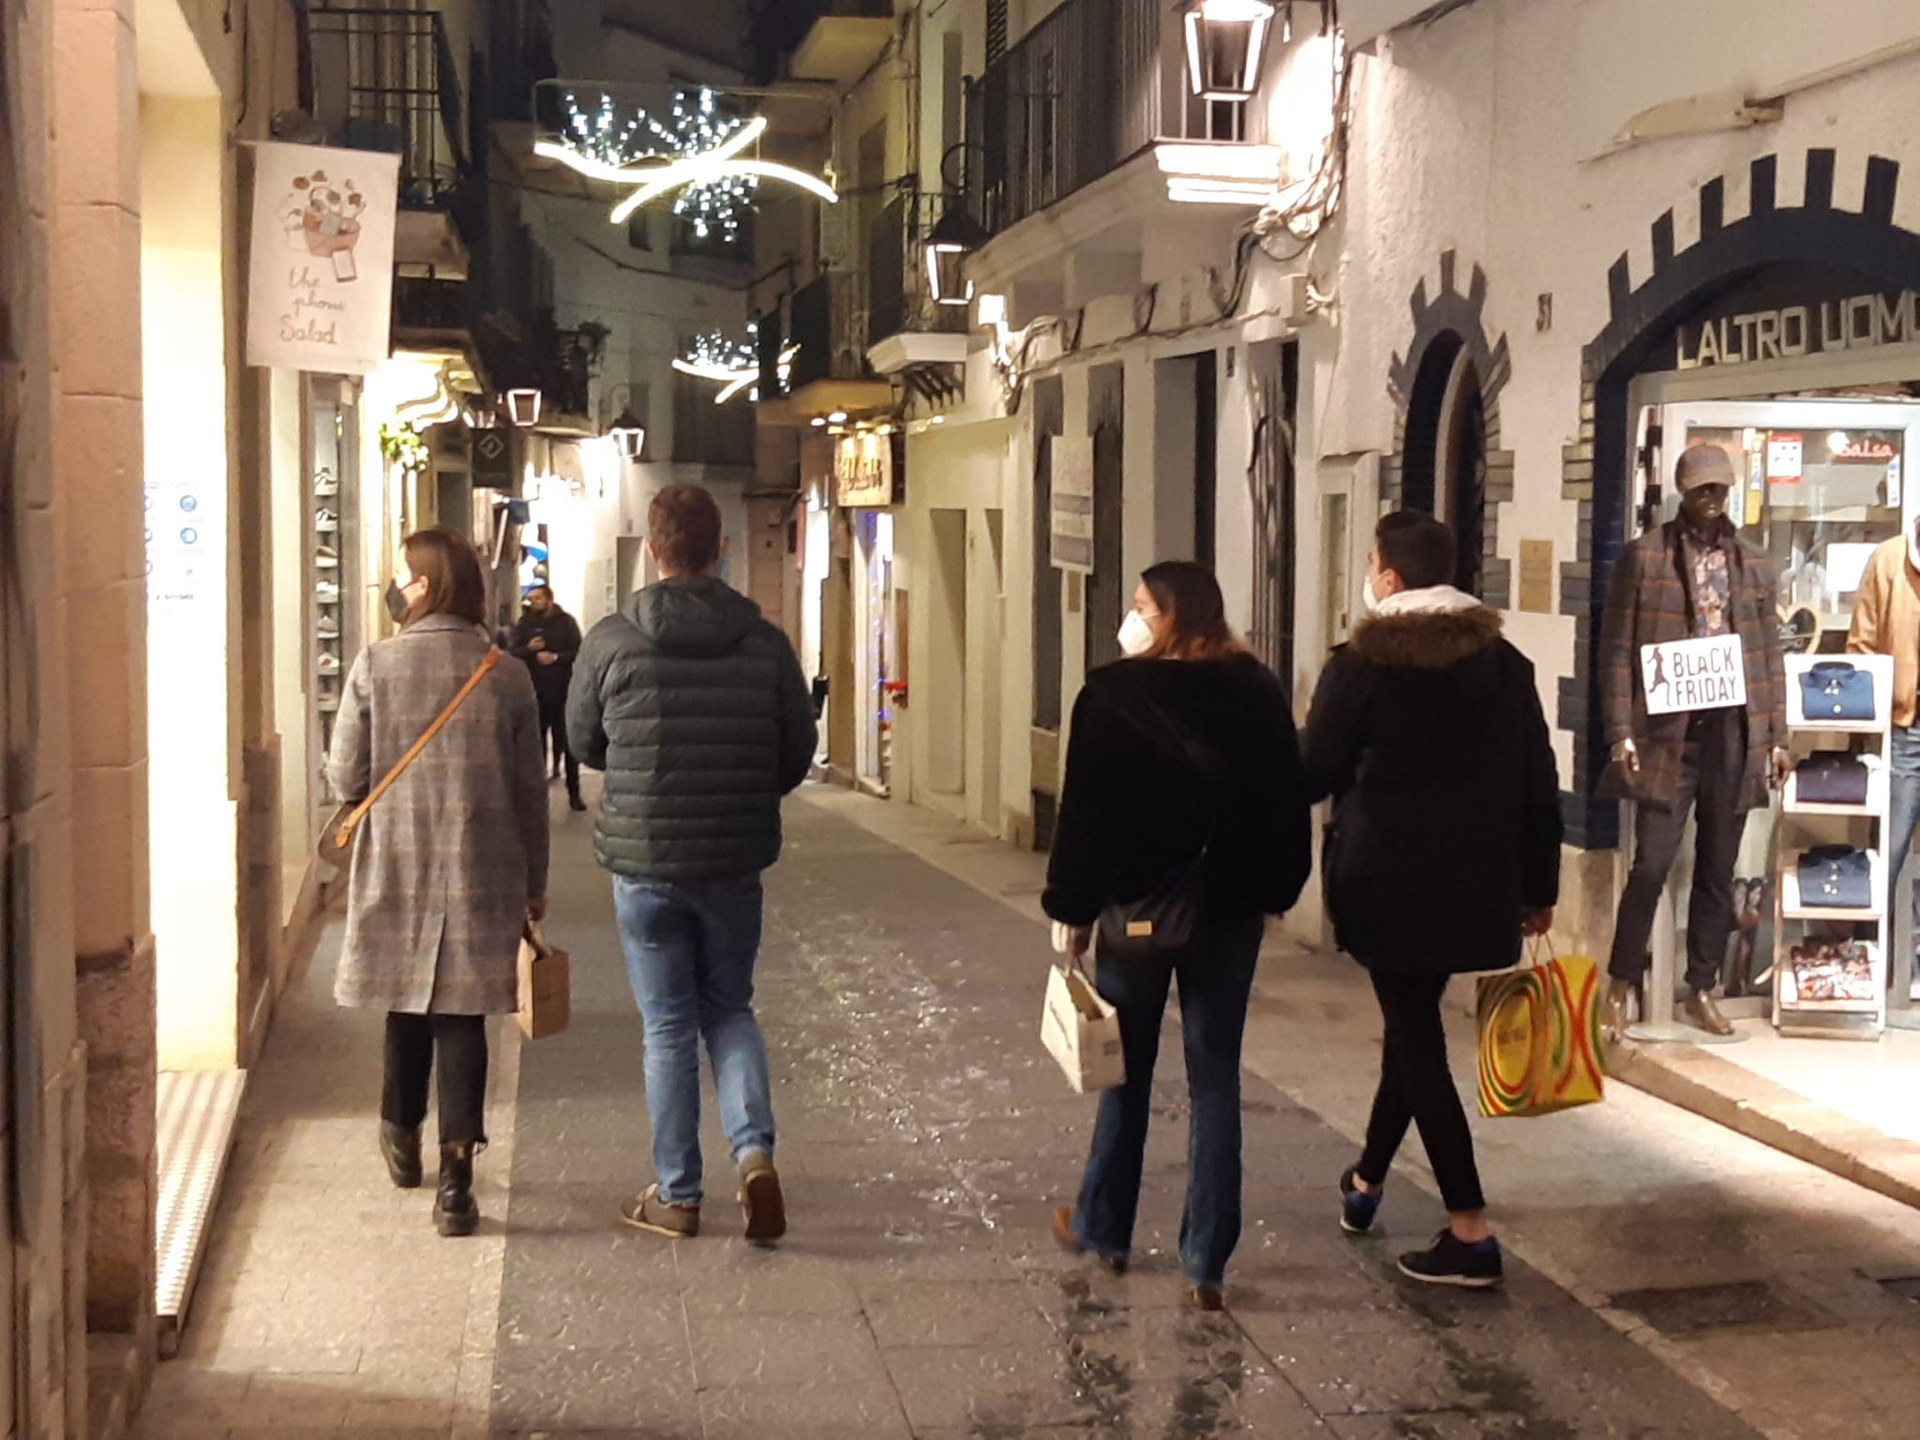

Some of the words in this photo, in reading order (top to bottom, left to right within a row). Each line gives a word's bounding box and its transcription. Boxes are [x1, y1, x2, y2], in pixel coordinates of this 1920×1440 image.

[280, 314, 338, 344] Salad
[1673, 646, 1734, 678] BLACK
[1675, 676, 1736, 706] FRIDAY
